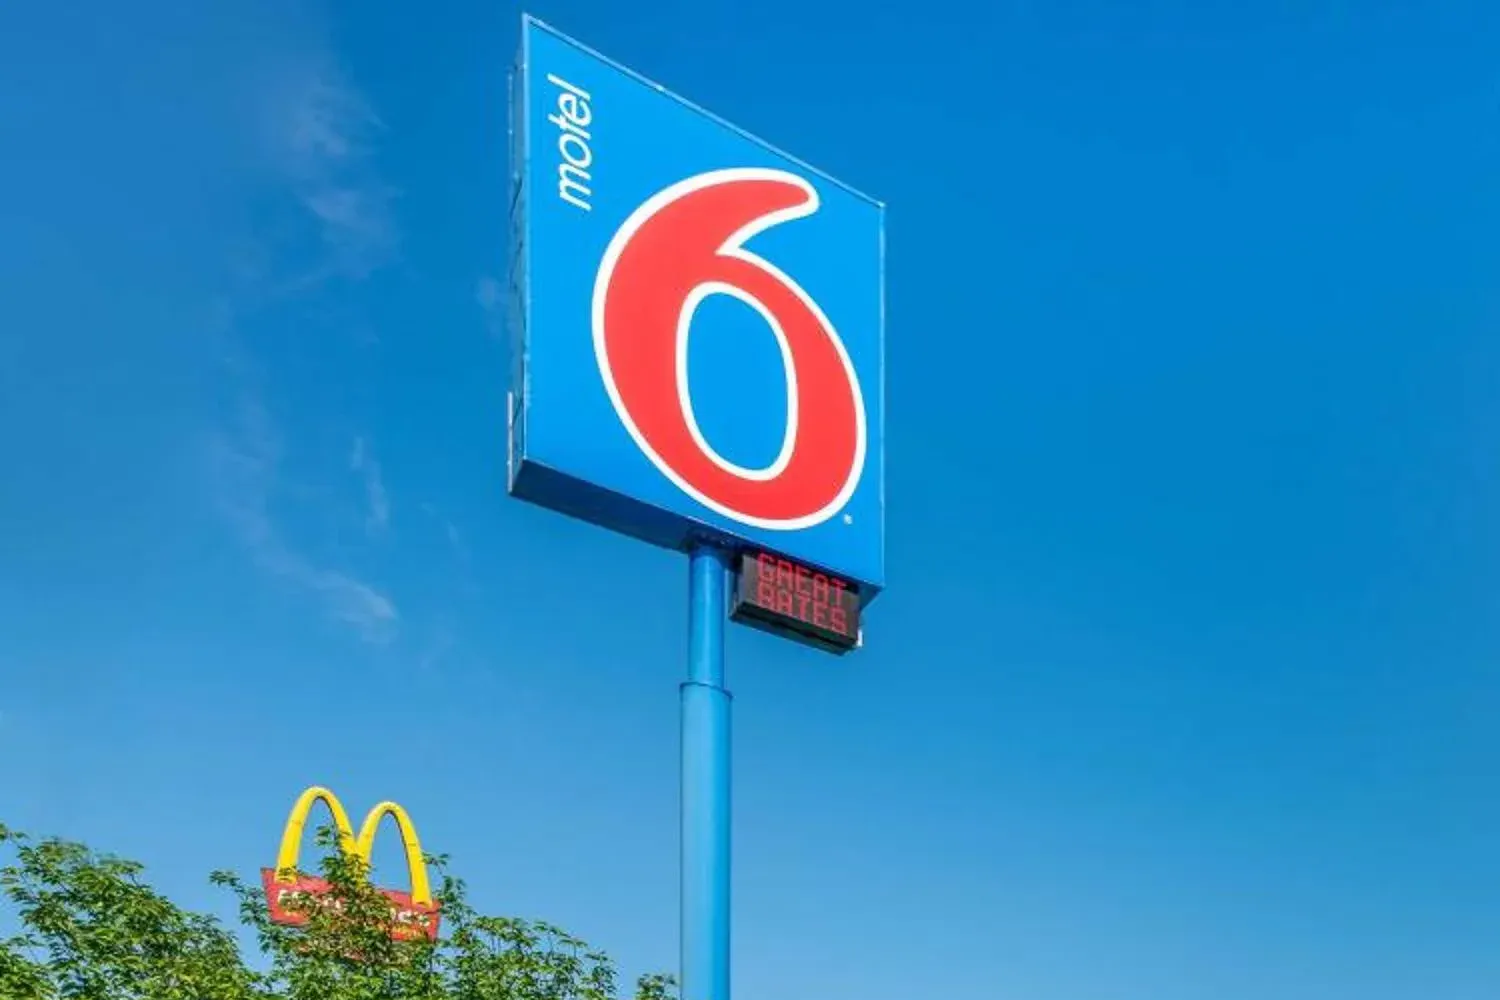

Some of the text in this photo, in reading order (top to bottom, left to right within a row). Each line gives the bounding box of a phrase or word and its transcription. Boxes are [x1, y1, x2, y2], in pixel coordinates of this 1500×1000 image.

[547, 73, 592, 211] motel
[592, 168, 866, 530] 6
[756, 552, 848, 607] GREAT
[756, 582, 849, 635] RATES
